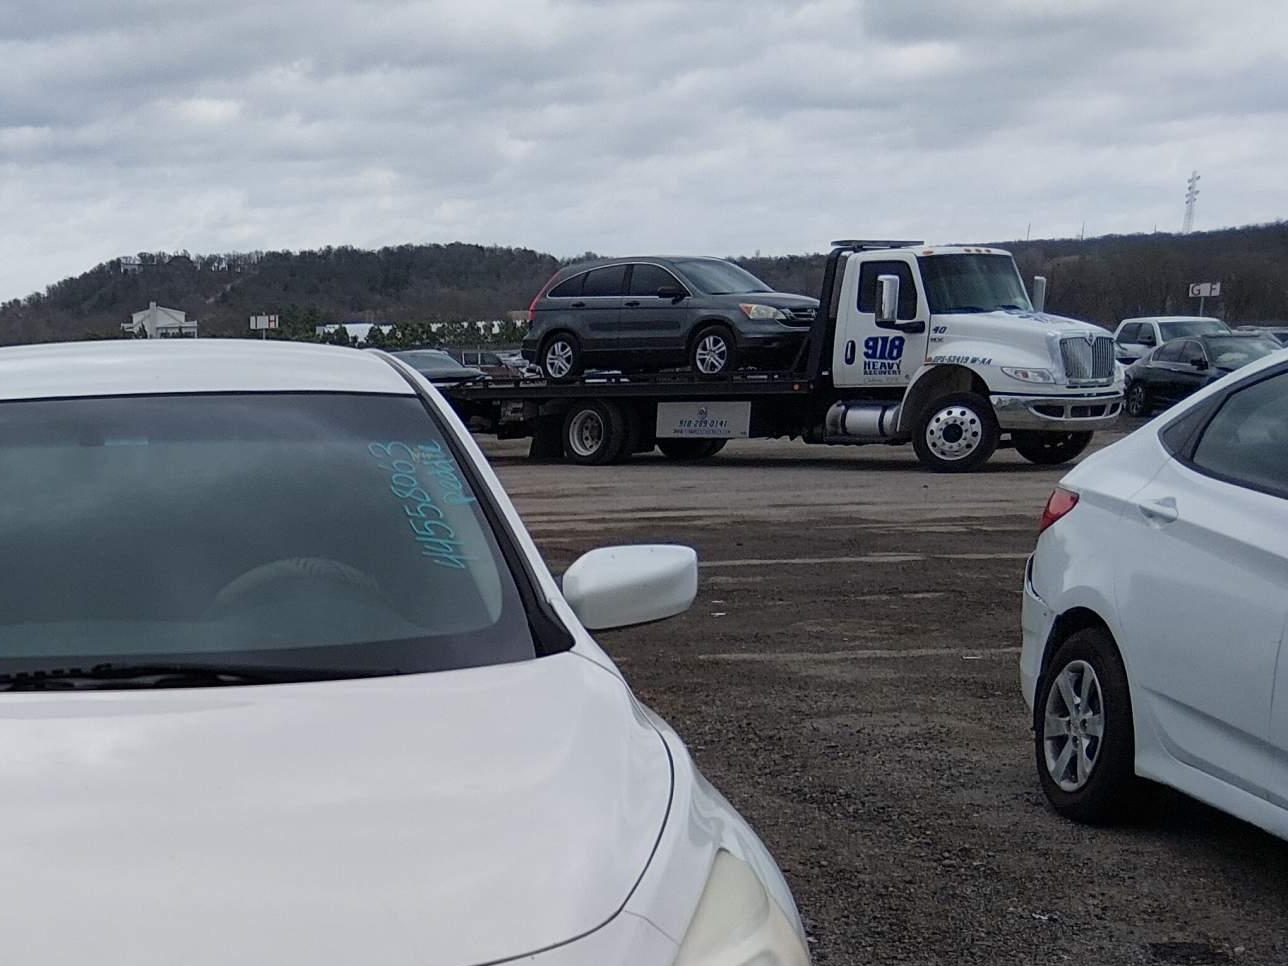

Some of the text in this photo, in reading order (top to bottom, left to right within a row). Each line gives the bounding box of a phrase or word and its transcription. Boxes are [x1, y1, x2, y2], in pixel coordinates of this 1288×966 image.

[1192, 284, 1201, 295] G
[932, 326, 948, 334] 40
[863, 335, 906, 361] 918
[863, 360, 902, 370] HEAVY
[368, 441, 479, 569] 44558063
